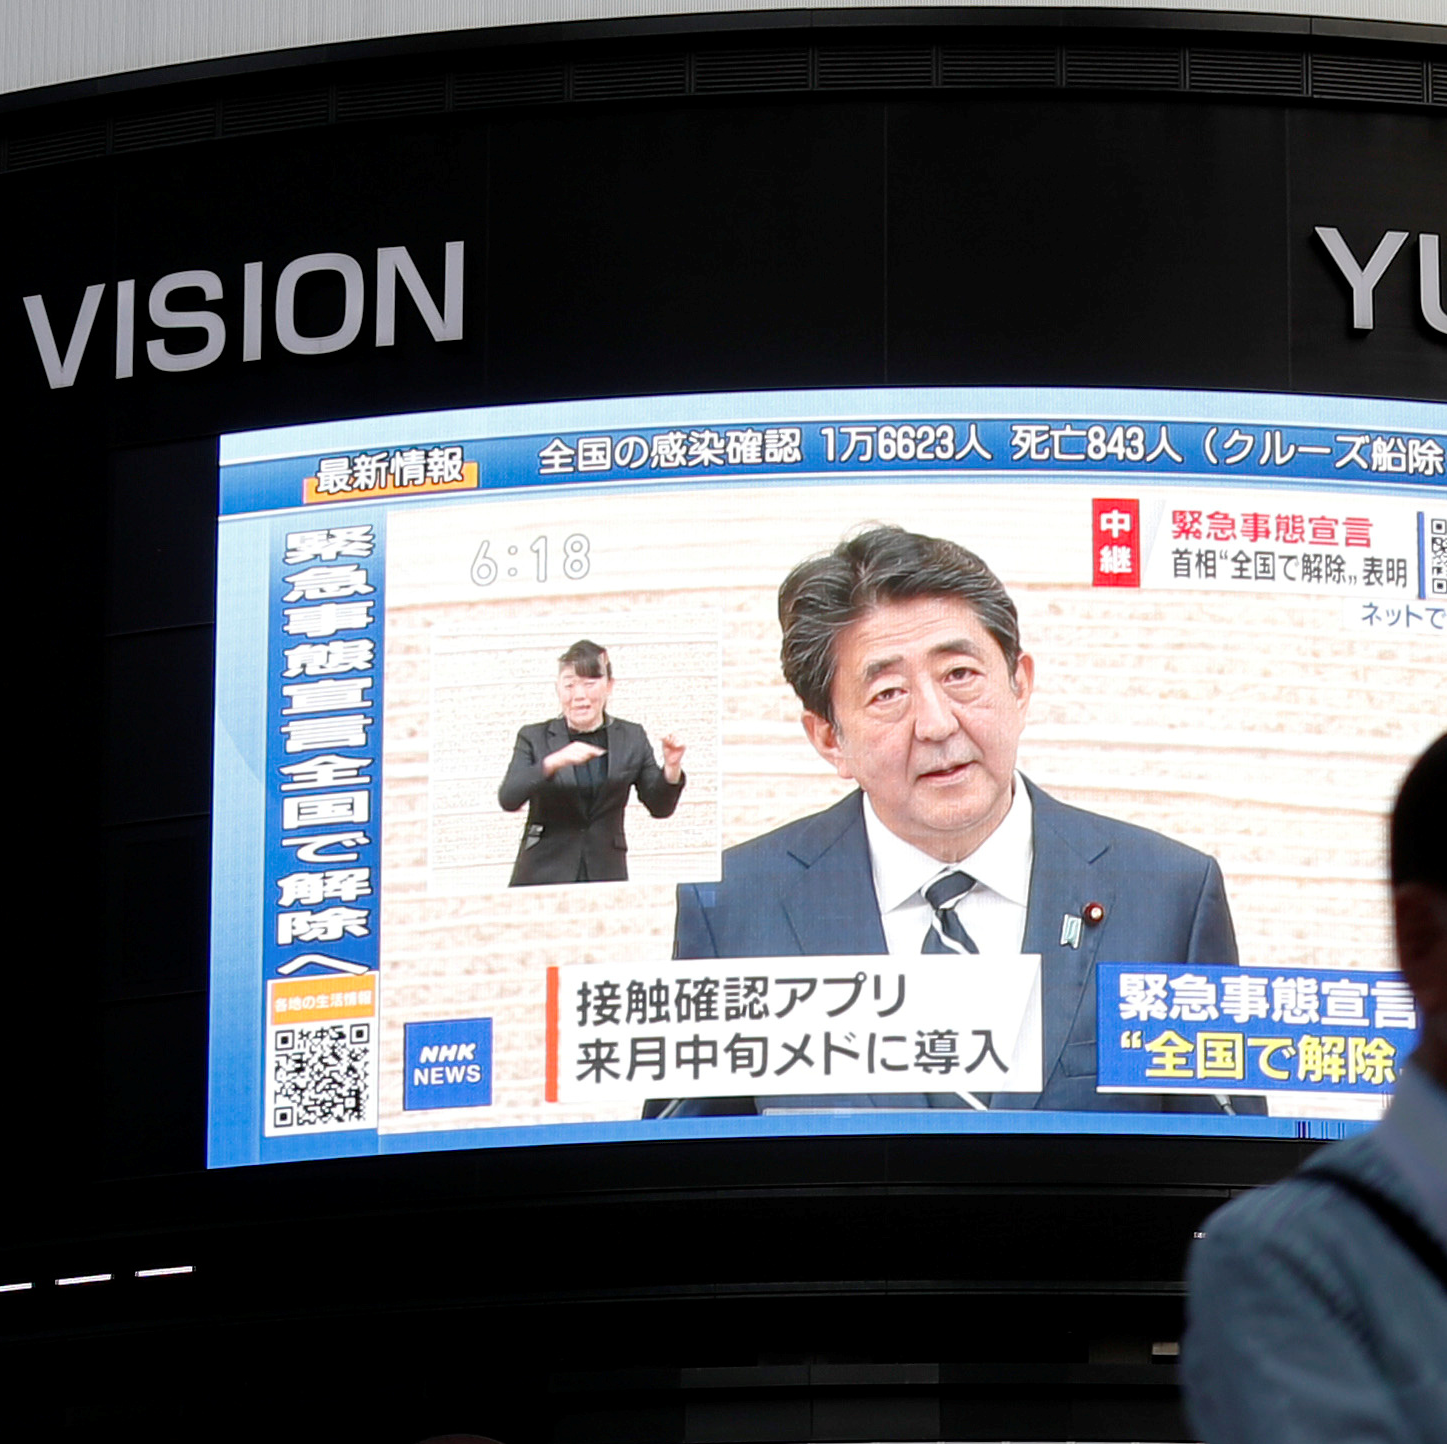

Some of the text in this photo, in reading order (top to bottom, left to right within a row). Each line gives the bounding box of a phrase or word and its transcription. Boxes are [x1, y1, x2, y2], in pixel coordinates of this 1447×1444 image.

[23, 241, 465, 389] VISION
[315, 447, 464, 494] 最新情報
[538, 427, 802, 475] 全国の感染確認
[820, 424, 992, 464] 1万6623人
[1099, 509, 1133, 575] 中継
[1171, 512, 1373, 548] 緊急事態宣言
[470, 533, 590, 587] 6:18
[276, 524, 375, 975] 緊急事態宣言全国で解除へ
[275, 989, 372, 1013] 各地の生活情報
[576, 971, 906, 1027] 接触確認アプリ
[1119, 972, 1417, 1030] 緊急事態宣言
[414, 1064, 482, 1086] NEWS
[420, 1042, 476, 1062] NHK
[576, 1028, 1009, 1084] 来月中旬メドに導入
[1121, 1029, 1398, 1085] “全国で解除
